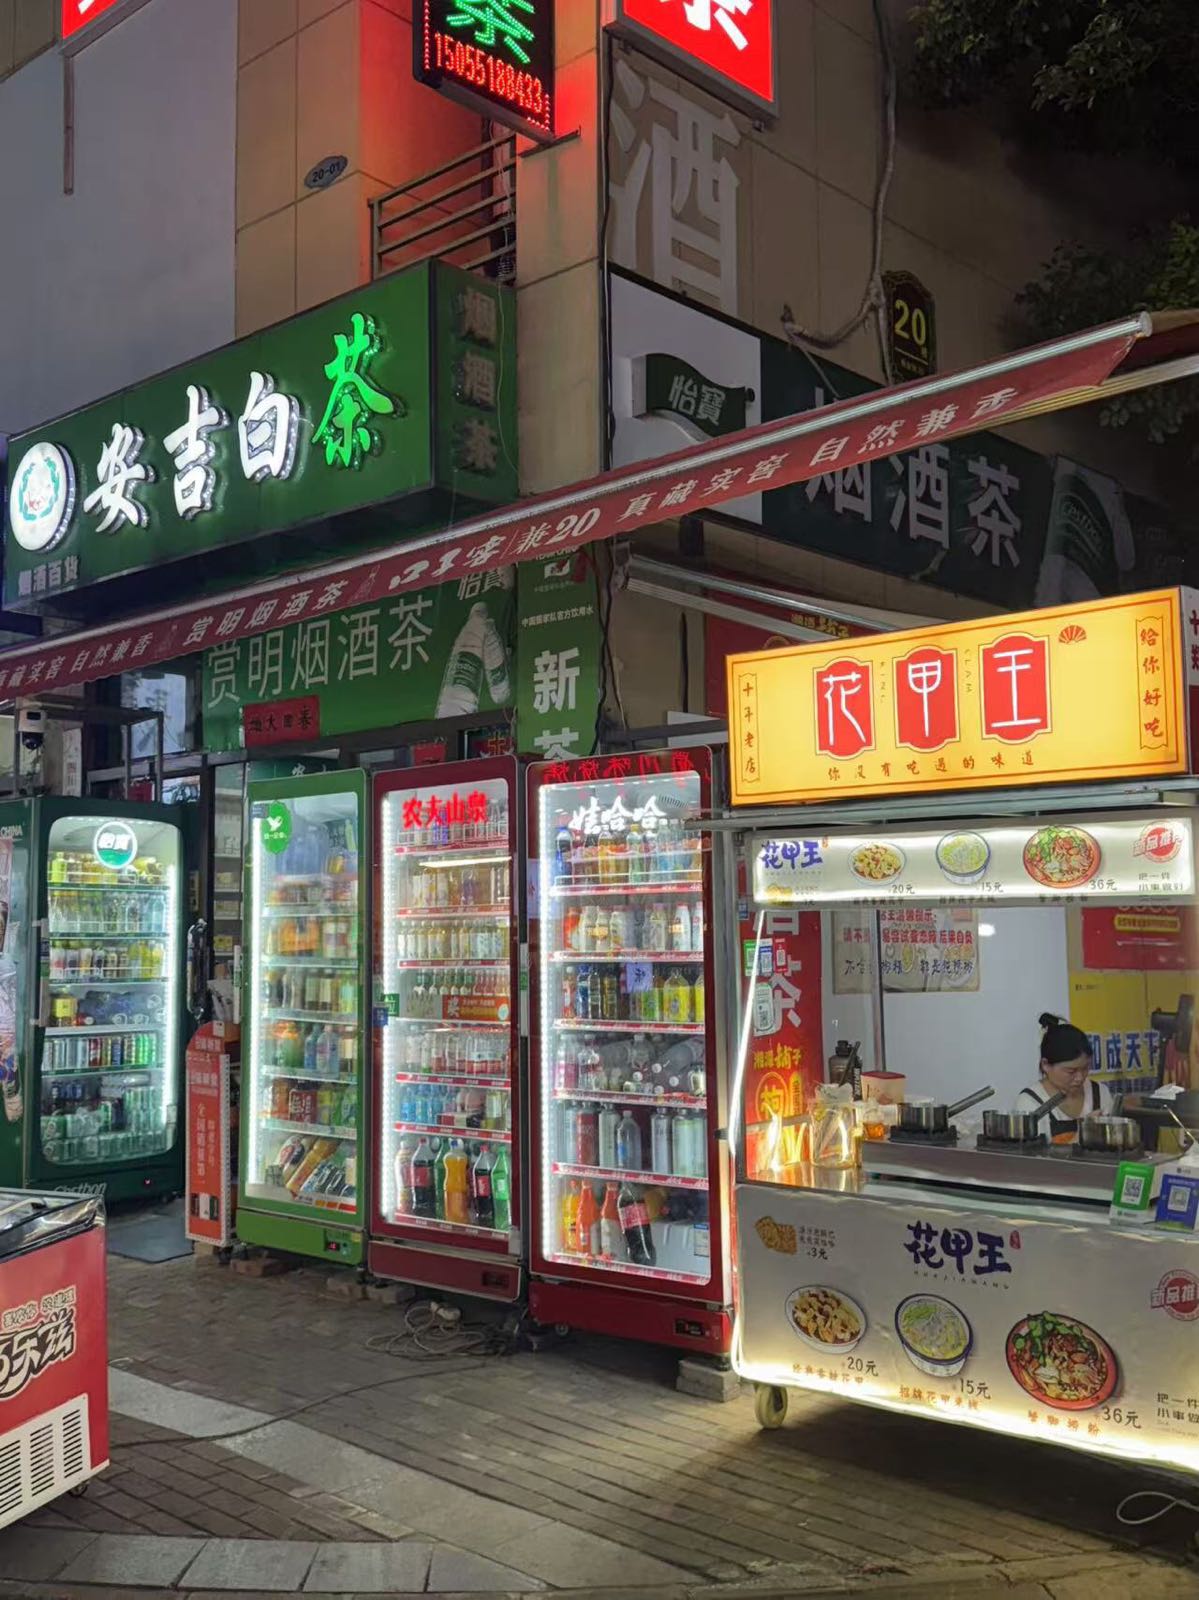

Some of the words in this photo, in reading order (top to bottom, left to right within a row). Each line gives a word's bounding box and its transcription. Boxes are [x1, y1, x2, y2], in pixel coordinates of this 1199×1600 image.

[434, 32, 542, 113] 15055188433
[312, 161, 341, 183] 20-01
[83, 311, 395, 533] 安吉白茶
[822, 648, 1041, 747] 花甲王
[402, 789, 488, 830] 农夫山泉
[568, 796, 667, 835] 娃哈哈
[761, 840, 823, 870] 花甲王
[903, 1220, 1012, 1275] 花甲王
[846, 1356, 879, 1377] 20元
[959, 1378, 991, 1399] 15元
[1101, 1406, 1142, 1429] 36元
